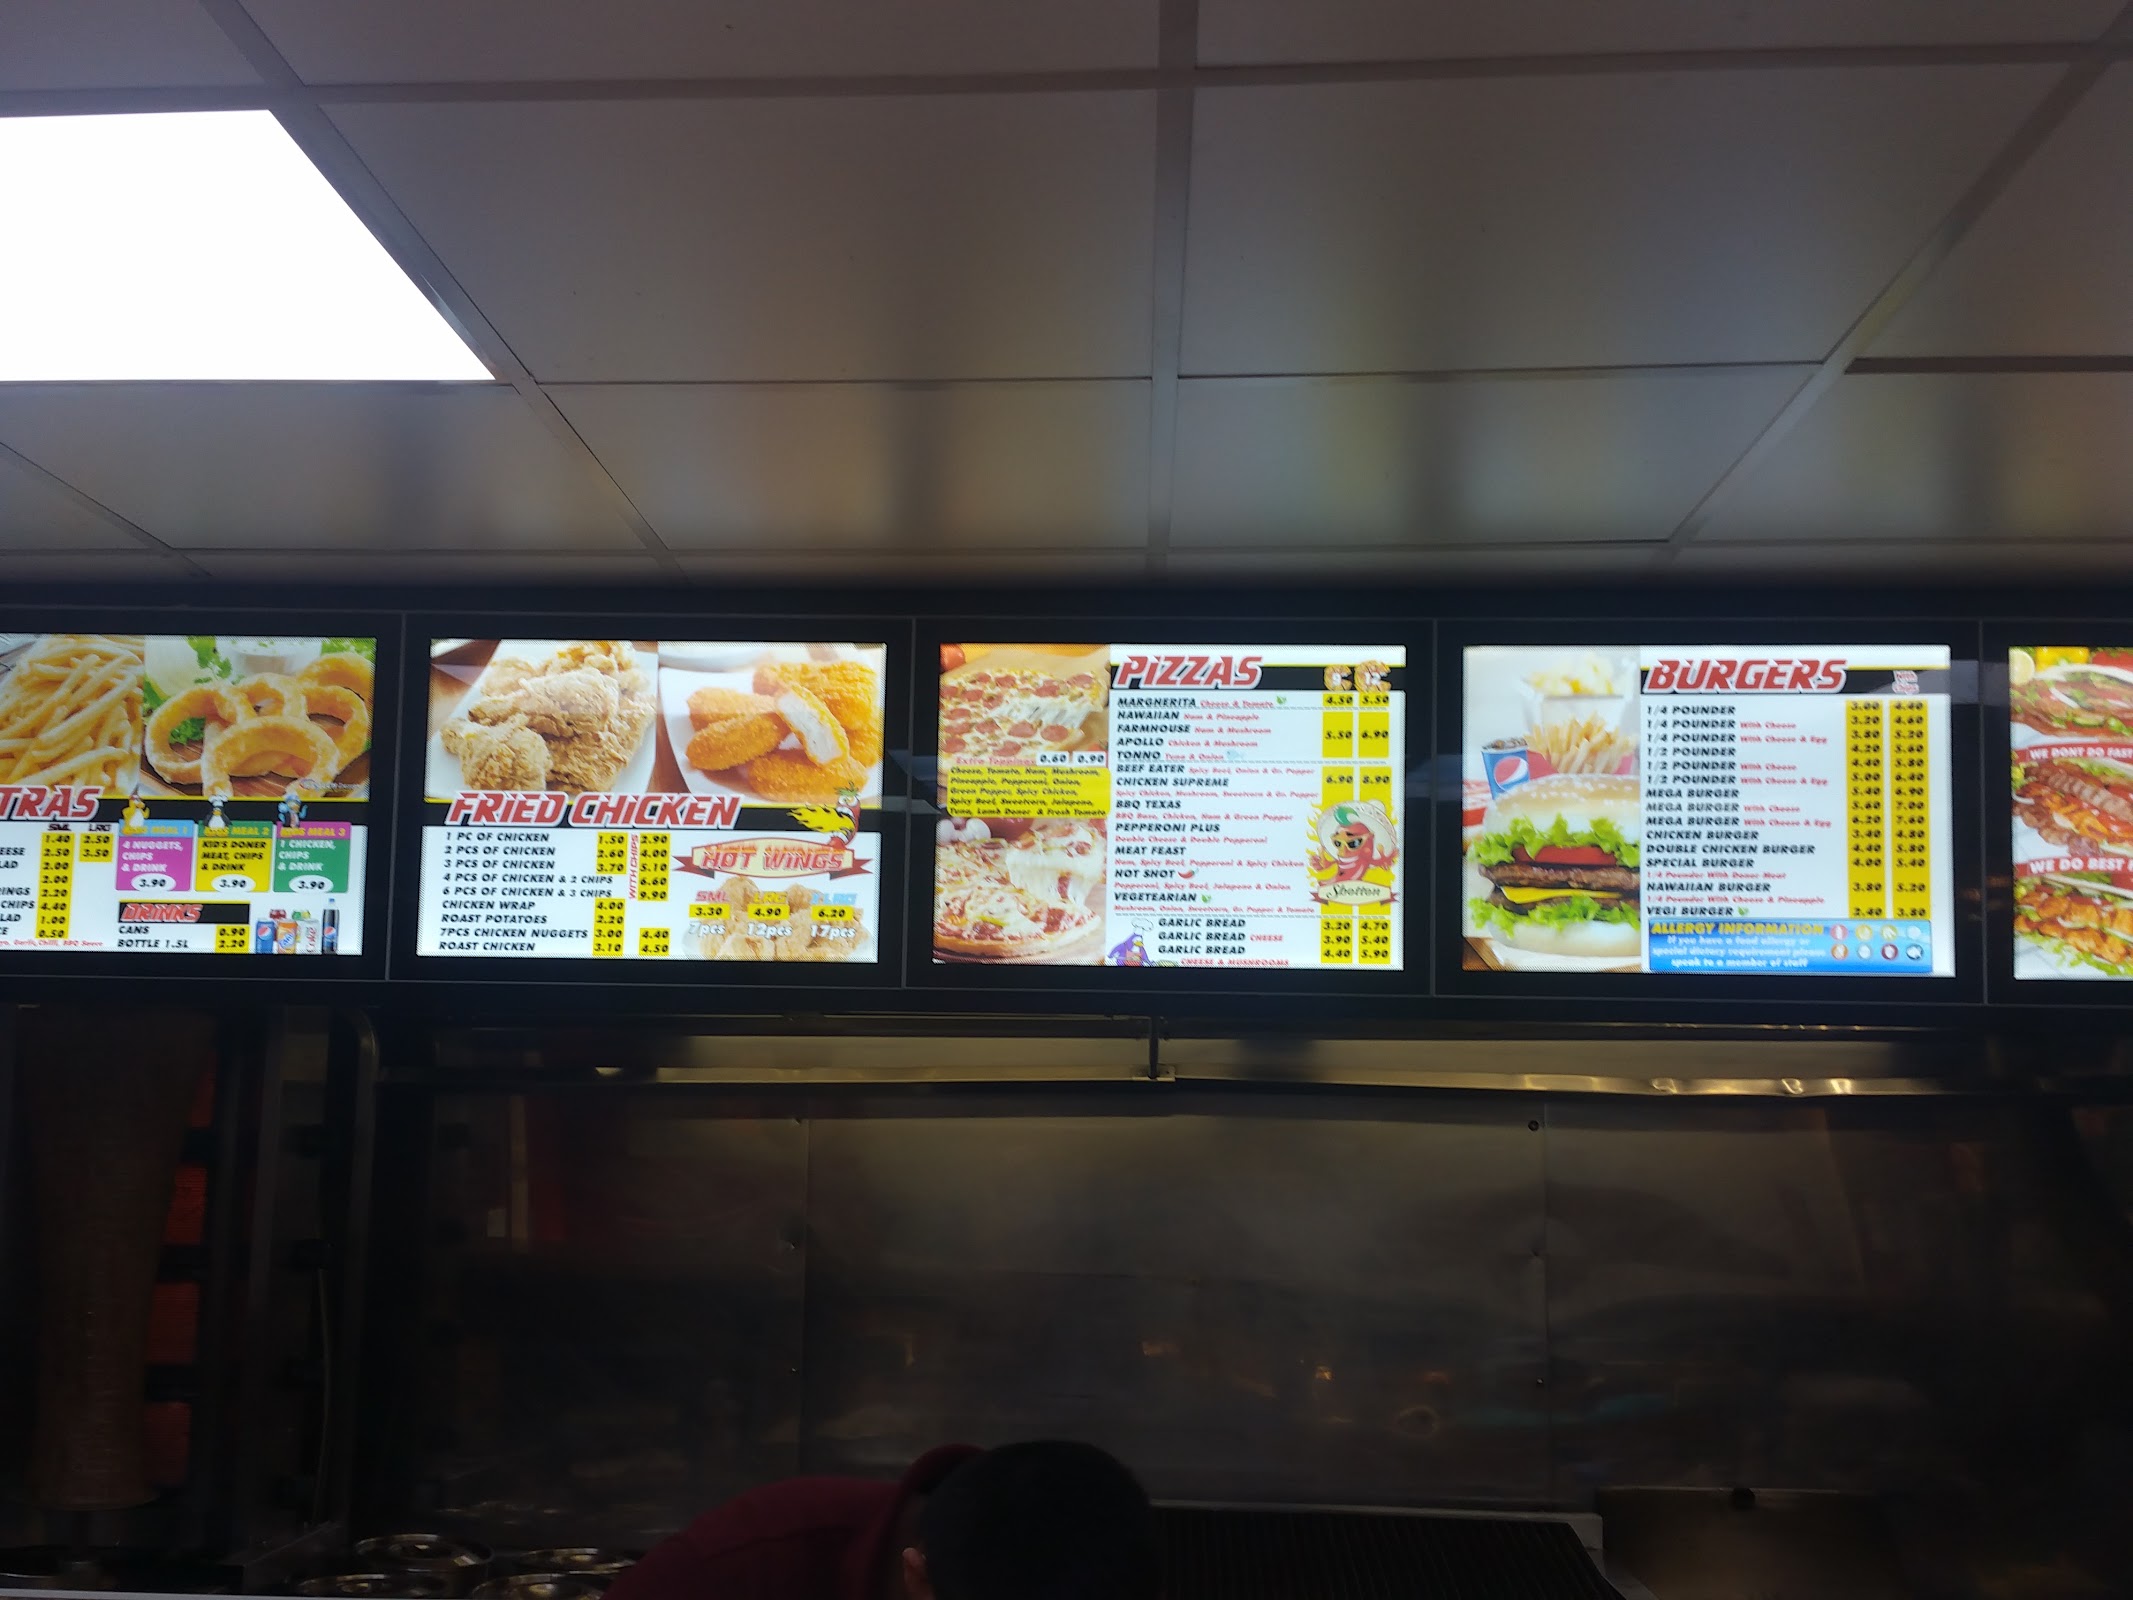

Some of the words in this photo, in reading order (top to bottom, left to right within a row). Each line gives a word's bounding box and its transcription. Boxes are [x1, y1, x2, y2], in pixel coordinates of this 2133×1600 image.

[1643, 659, 1848, 693] BURGERS
[1117, 711, 1179, 719] HAWAIIAN
[1117, 725, 1190, 733] FARMHOUSE
[1117, 738, 1164, 746] APOLLO
[1648, 734, 1667, 743] 1/4
[1672, 734, 1736, 742] POUNDER
[1117, 751, 1161, 759] TONNO
[2030, 749, 2048, 759] WE
[2051, 748, 2084, 757] DONT
[2087, 748, 2104, 757] DO
[1040, 755, 1067, 763] 0.60
[1077, 755, 1104, 763] 0.90
[1117, 765, 1144, 773] BEEF
[1150, 765, 1185, 773] EATER
[1117, 778, 1168, 786] CHICKEN
[1172, 778, 1229, 786] SUPREME
[1648, 775, 1667, 784] 1/2
[1672, 775, 1736, 784] POUNDER
[1646, 789, 1682, 798] MEGA
[1688, 789, 1739, 798] BURGER
[1116, 800, 1140, 808] BBQ
[1145, 800, 1181, 808] TEXAS
[445, 791, 569, 826] FRIED
[569, 792, 744, 828] CHICKEN
[88, 824, 111, 832] LRG
[308, 828, 335, 836] MEAL
[1116, 824, 1186, 832] PEPPERONI
[1190, 824, 1220, 832] PLUS
[45, 835, 71, 843] 1.40
[83, 836, 110, 844] 2.50
[446, 832, 451, 841] 1
[457, 833, 473, 841] PC
[477, 833, 492, 841] OF
[497, 833, 549, 842] CHICKEN
[599, 836, 624, 844] 1.50
[641, 836, 668, 844] 2.90
[1647, 831, 1702, 839] CHICKEN
[1707, 831, 1759, 839] BURGER
[122, 841, 130, 849] 4
[132, 841, 183, 851] NUGGETS,
[231, 841, 266, 849] DONER
[1647, 845, 1697, 853] DOUBLE
[1702, 845, 1757, 853] CHICKEN
[1762, 845, 1815, 854] BURGER
[44, 849, 70, 857] 2.50
[83, 849, 109, 857] 3.50
[445, 847, 451, 855] 2
[456, 847, 477, 855] PCS
[483, 847, 499, 855] OF
[503, 847, 555, 856] CHICKEN
[598, 850, 624, 858] 2.60
[640, 850, 667, 858] 4.00
[630, 834, 638, 872] CHIPS
[1115, 846, 1148, 855] MEAT
[1151, 847, 1186, 855] FEAST
[122, 852, 153, 860] CHIPS
[279, 852, 309, 860] CHIPS
[700, 846, 759, 870] HOT
[762, 846, 846, 871] WINGS
[121, 864, 130, 872] &
[132, 864, 167, 872] DRINK
[278, 863, 285, 871] &
[289, 863, 323, 871] DRINK
[1647, 859, 1697, 867] SPECIAL
[1702, 859, 1754, 868] BURGER
[2030, 860, 2055, 874] WE
[2059, 858, 2083, 869] DO
[2088, 858, 2124, 871] BEST
[139, 879, 166, 887] 3.90
[219, 880, 246, 888] 3.90
[443, 873, 450, 882] 4
[455, 873, 476, 882] PCS
[482, 874, 498, 883] OF
[502, 874, 554, 883] CHICKEN
[559, 875, 567, 883] &
[570, 875, 577, 883] 2
[581, 875, 613, 884] CHIPS
[640, 877, 667, 886] 6.60
[298, 881, 325, 889] 3.90
[629, 874, 637, 899] WITH
[1647, 883, 1713, 891] HAWAIIAN
[1718, 883, 1771, 892] BURGER
[695, 891, 728, 902] SML
[754, 892, 787, 903] LRG
[1, 901, 35, 909] CHIPS
[41, 903, 66, 911] 4.40
[442, 901, 495, 910] CHICKEN
[499, 901, 535, 910] WRAP
[596, 901, 623, 910] 4.00
[120, 904, 203, 922] DRINKS
[695, 907, 723, 916] 3.30
[754, 907, 781, 917] 4.90
[818, 909, 845, 918] 6.20
[1647, 907, 1676, 915] VEGI
[1681, 907, 1733, 915] BURGER
[441, 914, 481, 923] ROAST
[486, 914, 547, 924] POTATOES
[596, 915, 623, 924] 2.20
[1158, 918, 1202, 927] GARLIC
[1206, 919, 1246, 927] BREAD
[1361, 922, 1388, 930] 4.70
[1651, 922, 1716, 934] ALLERGY
[1719, 923, 1824, 935] INFORMATION
[39, 930, 65, 938] 0.50
[119, 926, 149, 934] CANS
[440, 928, 470, 937] 7PCS
[474, 928, 527, 938] CHICKEN
[531, 929, 588, 938] NUGGETS
[595, 929, 622, 938] 3.00
[642, 930, 669, 939] 4.40
[688, 923, 726, 936] 7pcs
[747, 923, 792, 937] 12pcs
[810, 925, 856, 939] 17pcs
[1158, 932, 1202, 941] GARLIC
[1206, 932, 1246, 941] BREAD
[1361, 936, 1388, 944] 5.40
[118, 940, 159, 948] BOTTLE
[219, 940, 245, 948] 2.20
[439, 942, 478, 951] ROAST
[482, 942, 535, 951] CHICKEN
[594, 943, 621, 952] 3.10
[641, 944, 668, 953] 4.50
[1158, 946, 1202, 954] GARLIC
[1206, 946, 1246, 954] BREAD
